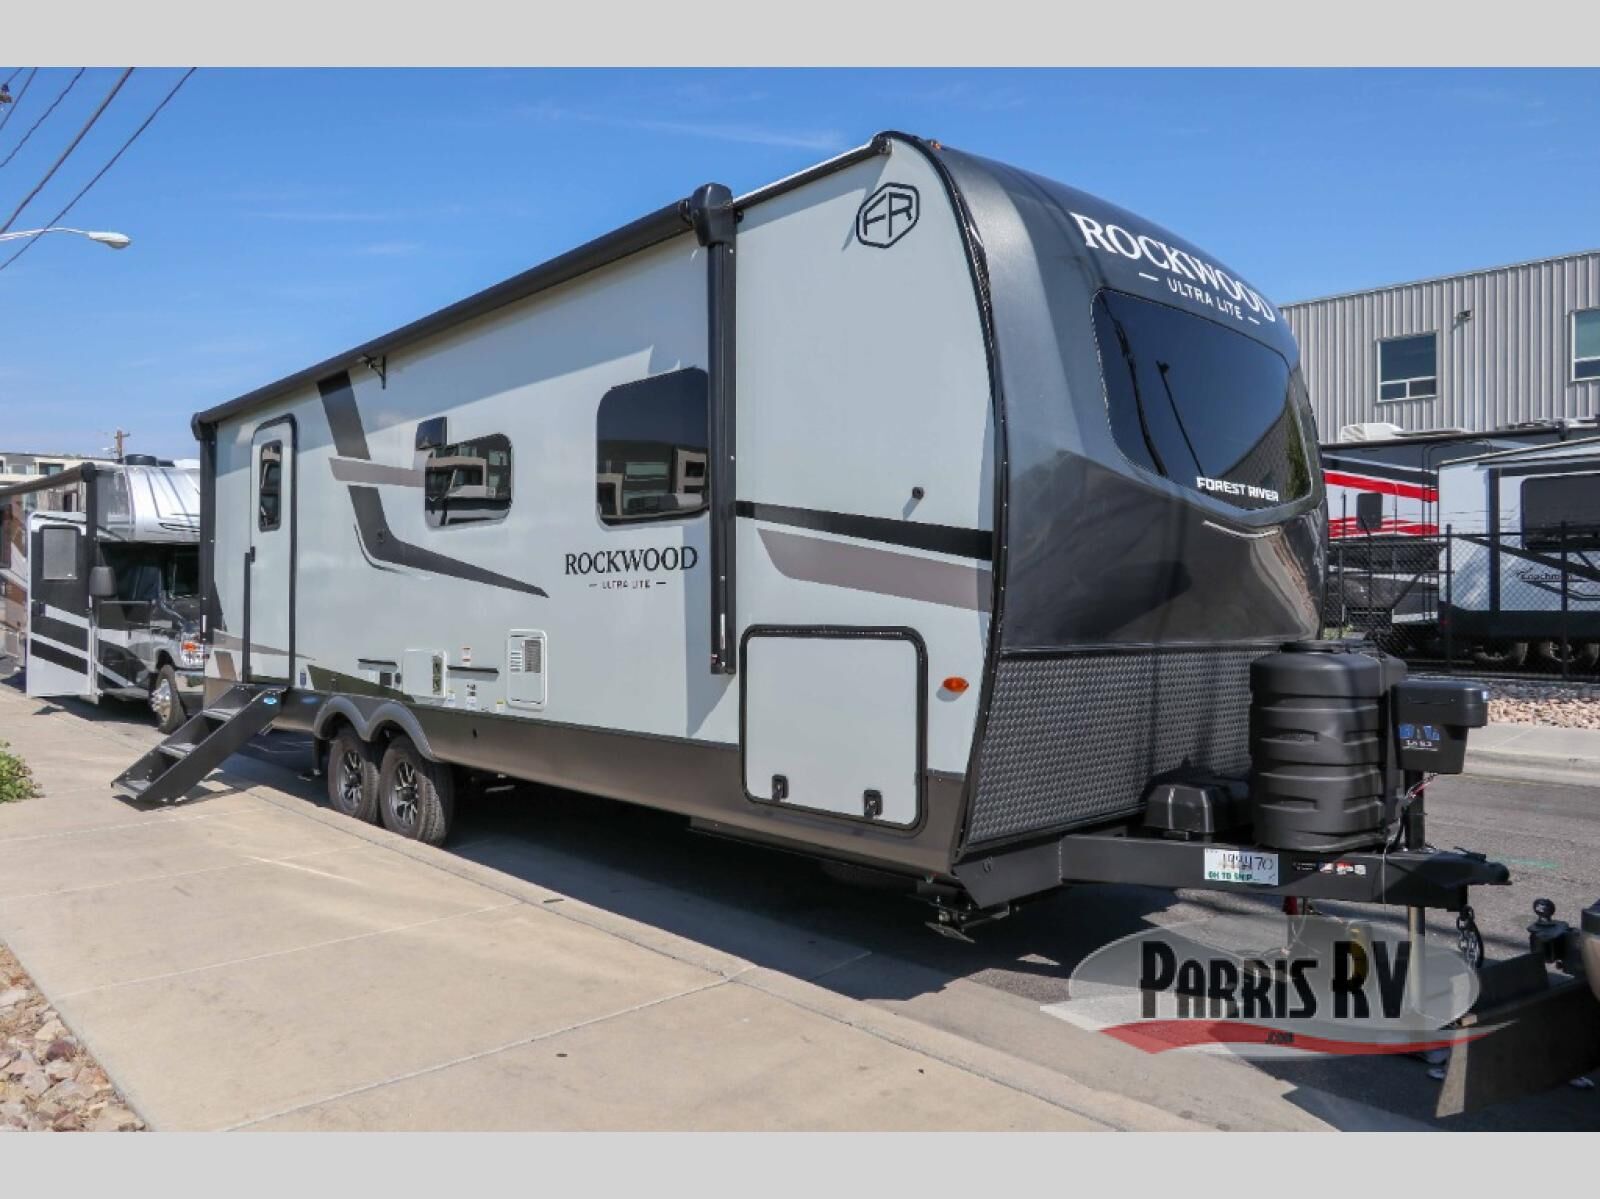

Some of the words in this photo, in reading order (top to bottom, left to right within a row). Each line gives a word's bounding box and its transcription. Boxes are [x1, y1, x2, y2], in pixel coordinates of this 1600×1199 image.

[1069, 211, 1276, 323] ROCKWOOD
[1166, 277, 1214, 306] ULTRA
[1216, 296, 1244, 321] LITE
[1196, 476, 1246, 495] FOREST
[1247, 485, 1279, 502] RIVER
[564, 545, 698, 575] ROCKWOOD
[602, 580, 628, 589] ULTRA
